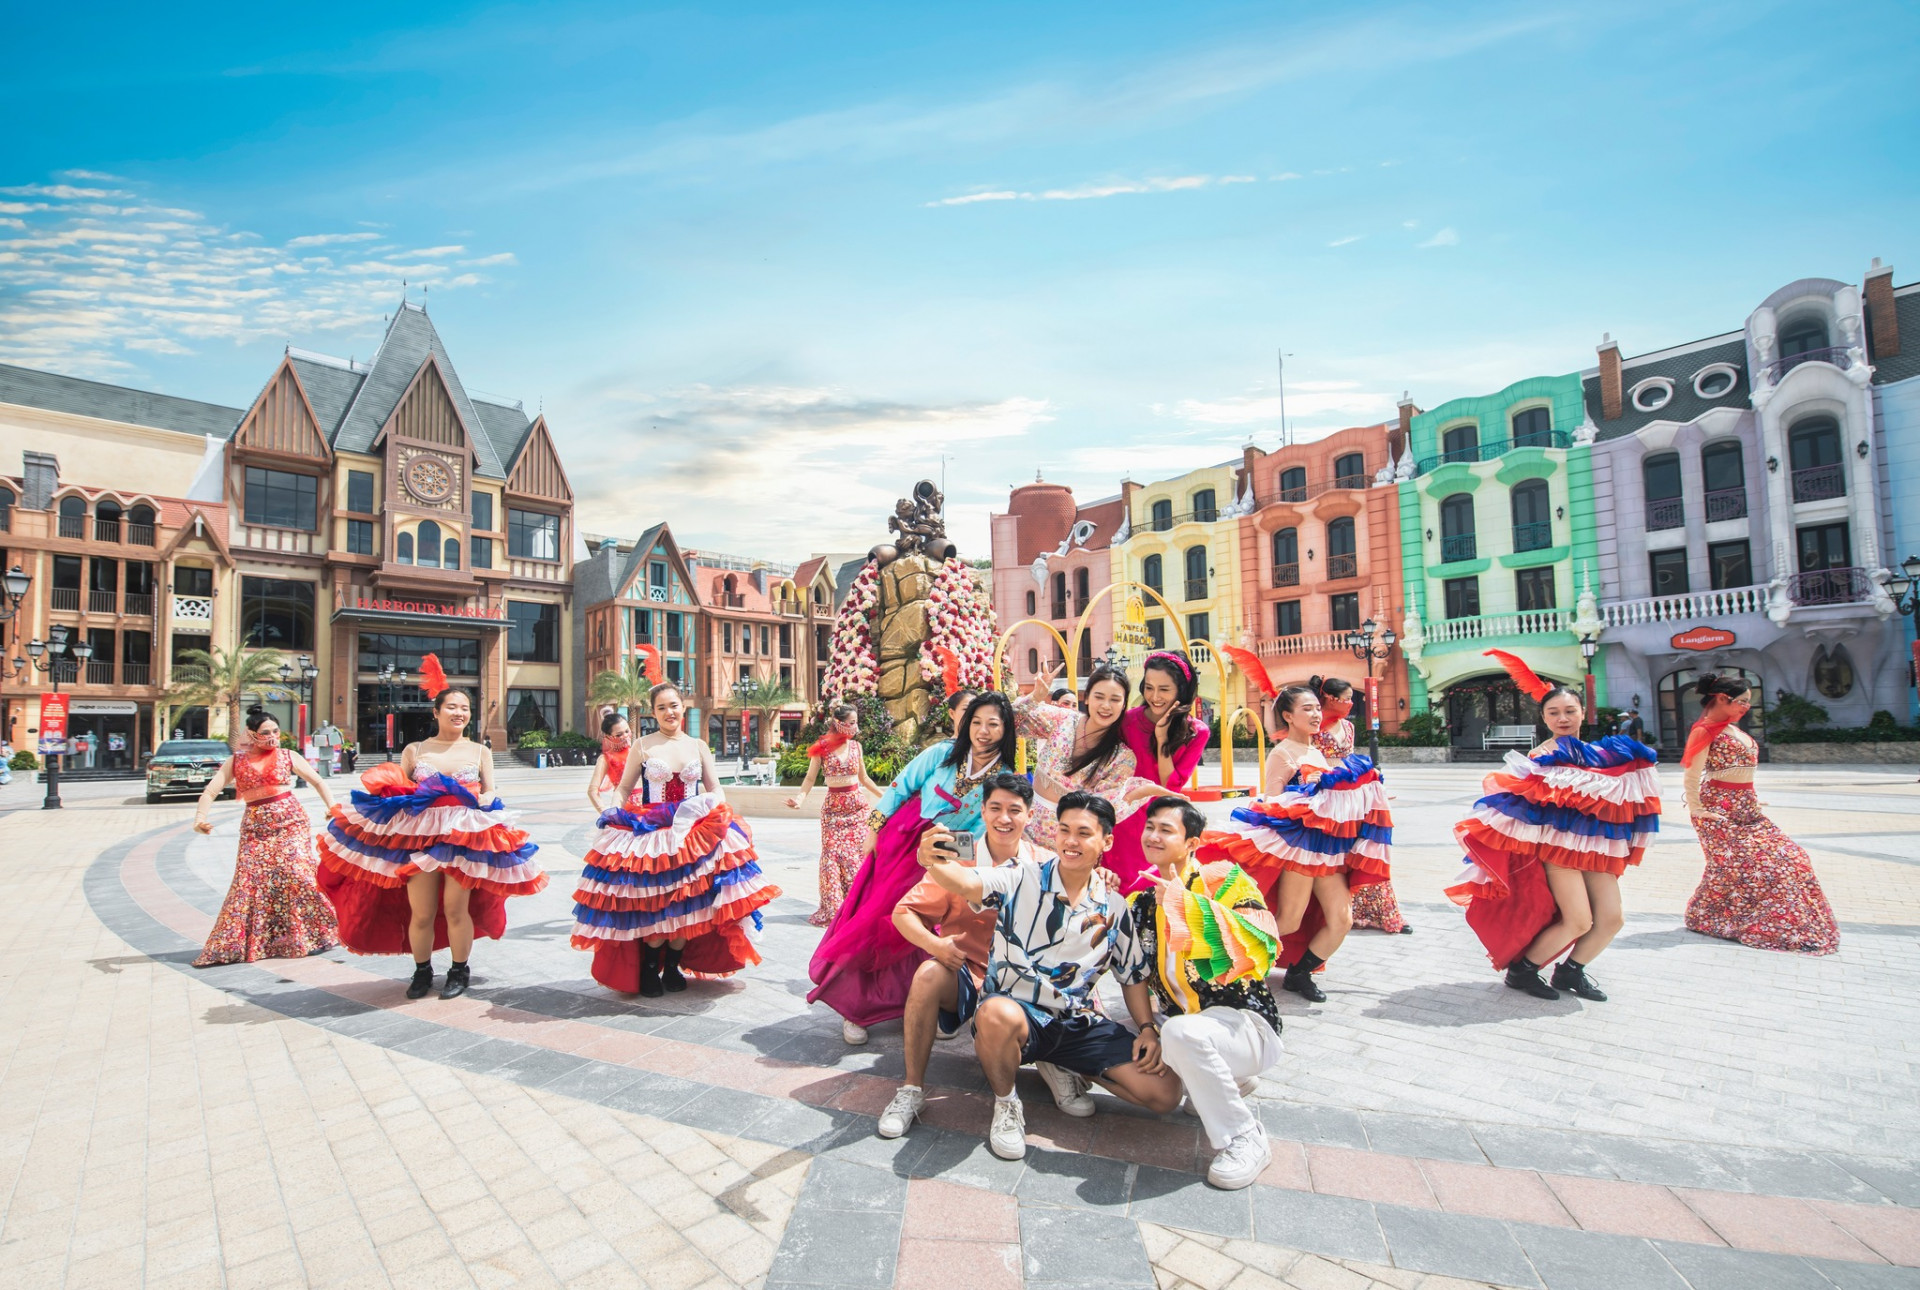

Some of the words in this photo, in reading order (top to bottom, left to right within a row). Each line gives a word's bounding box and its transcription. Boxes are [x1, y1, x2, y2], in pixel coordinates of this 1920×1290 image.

[357, 598, 437, 614] HARBOUR
[440, 604, 502, 620] MARKET
[1680, 634, 1725, 644] Langfarm
